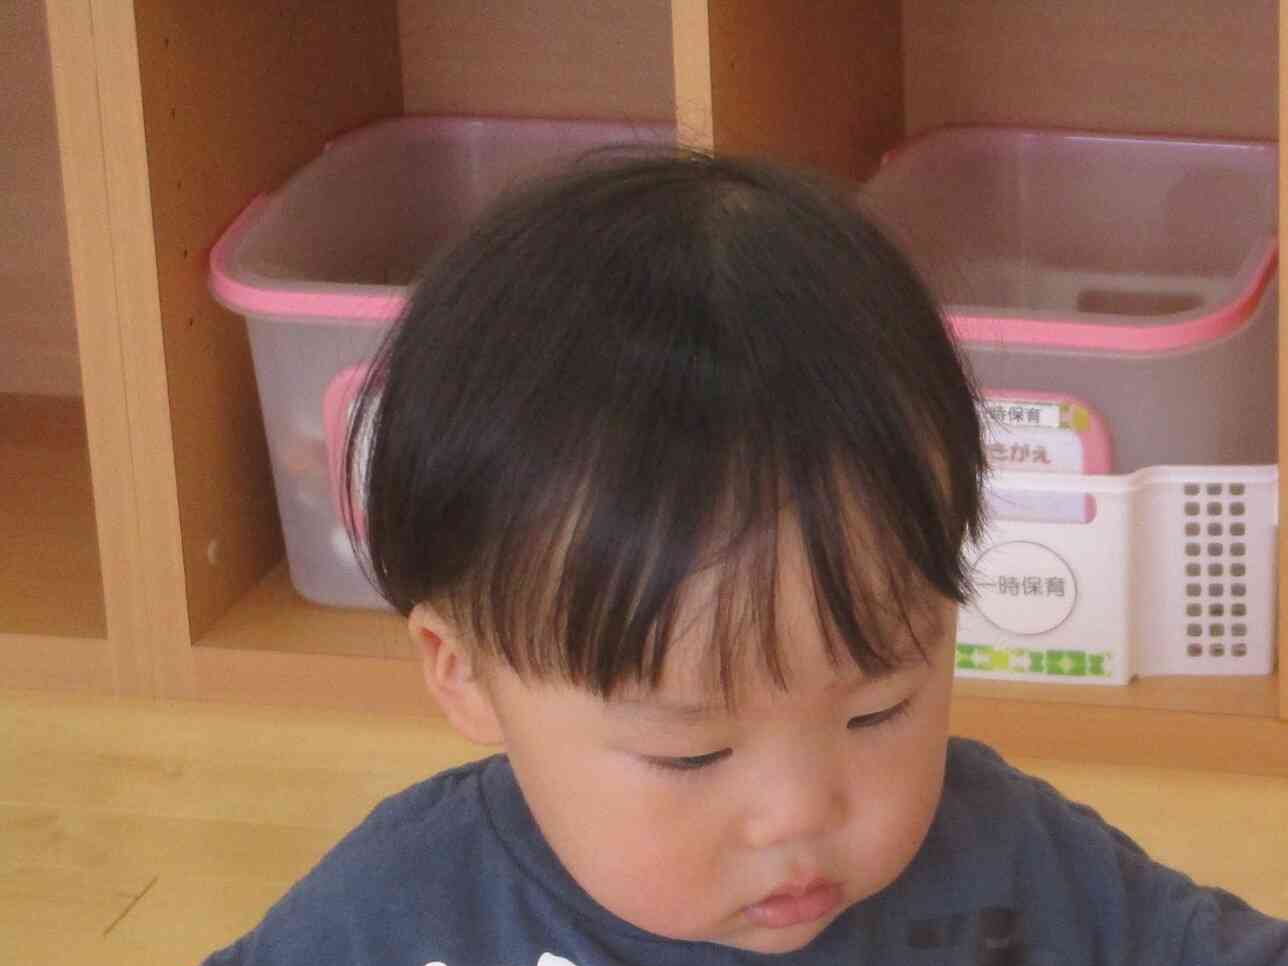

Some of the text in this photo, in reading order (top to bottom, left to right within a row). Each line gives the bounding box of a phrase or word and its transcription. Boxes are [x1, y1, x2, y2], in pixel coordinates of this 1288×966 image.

[990, 406, 1041, 424] 時保育
[976, 576, 1065, 597] 一時保育
